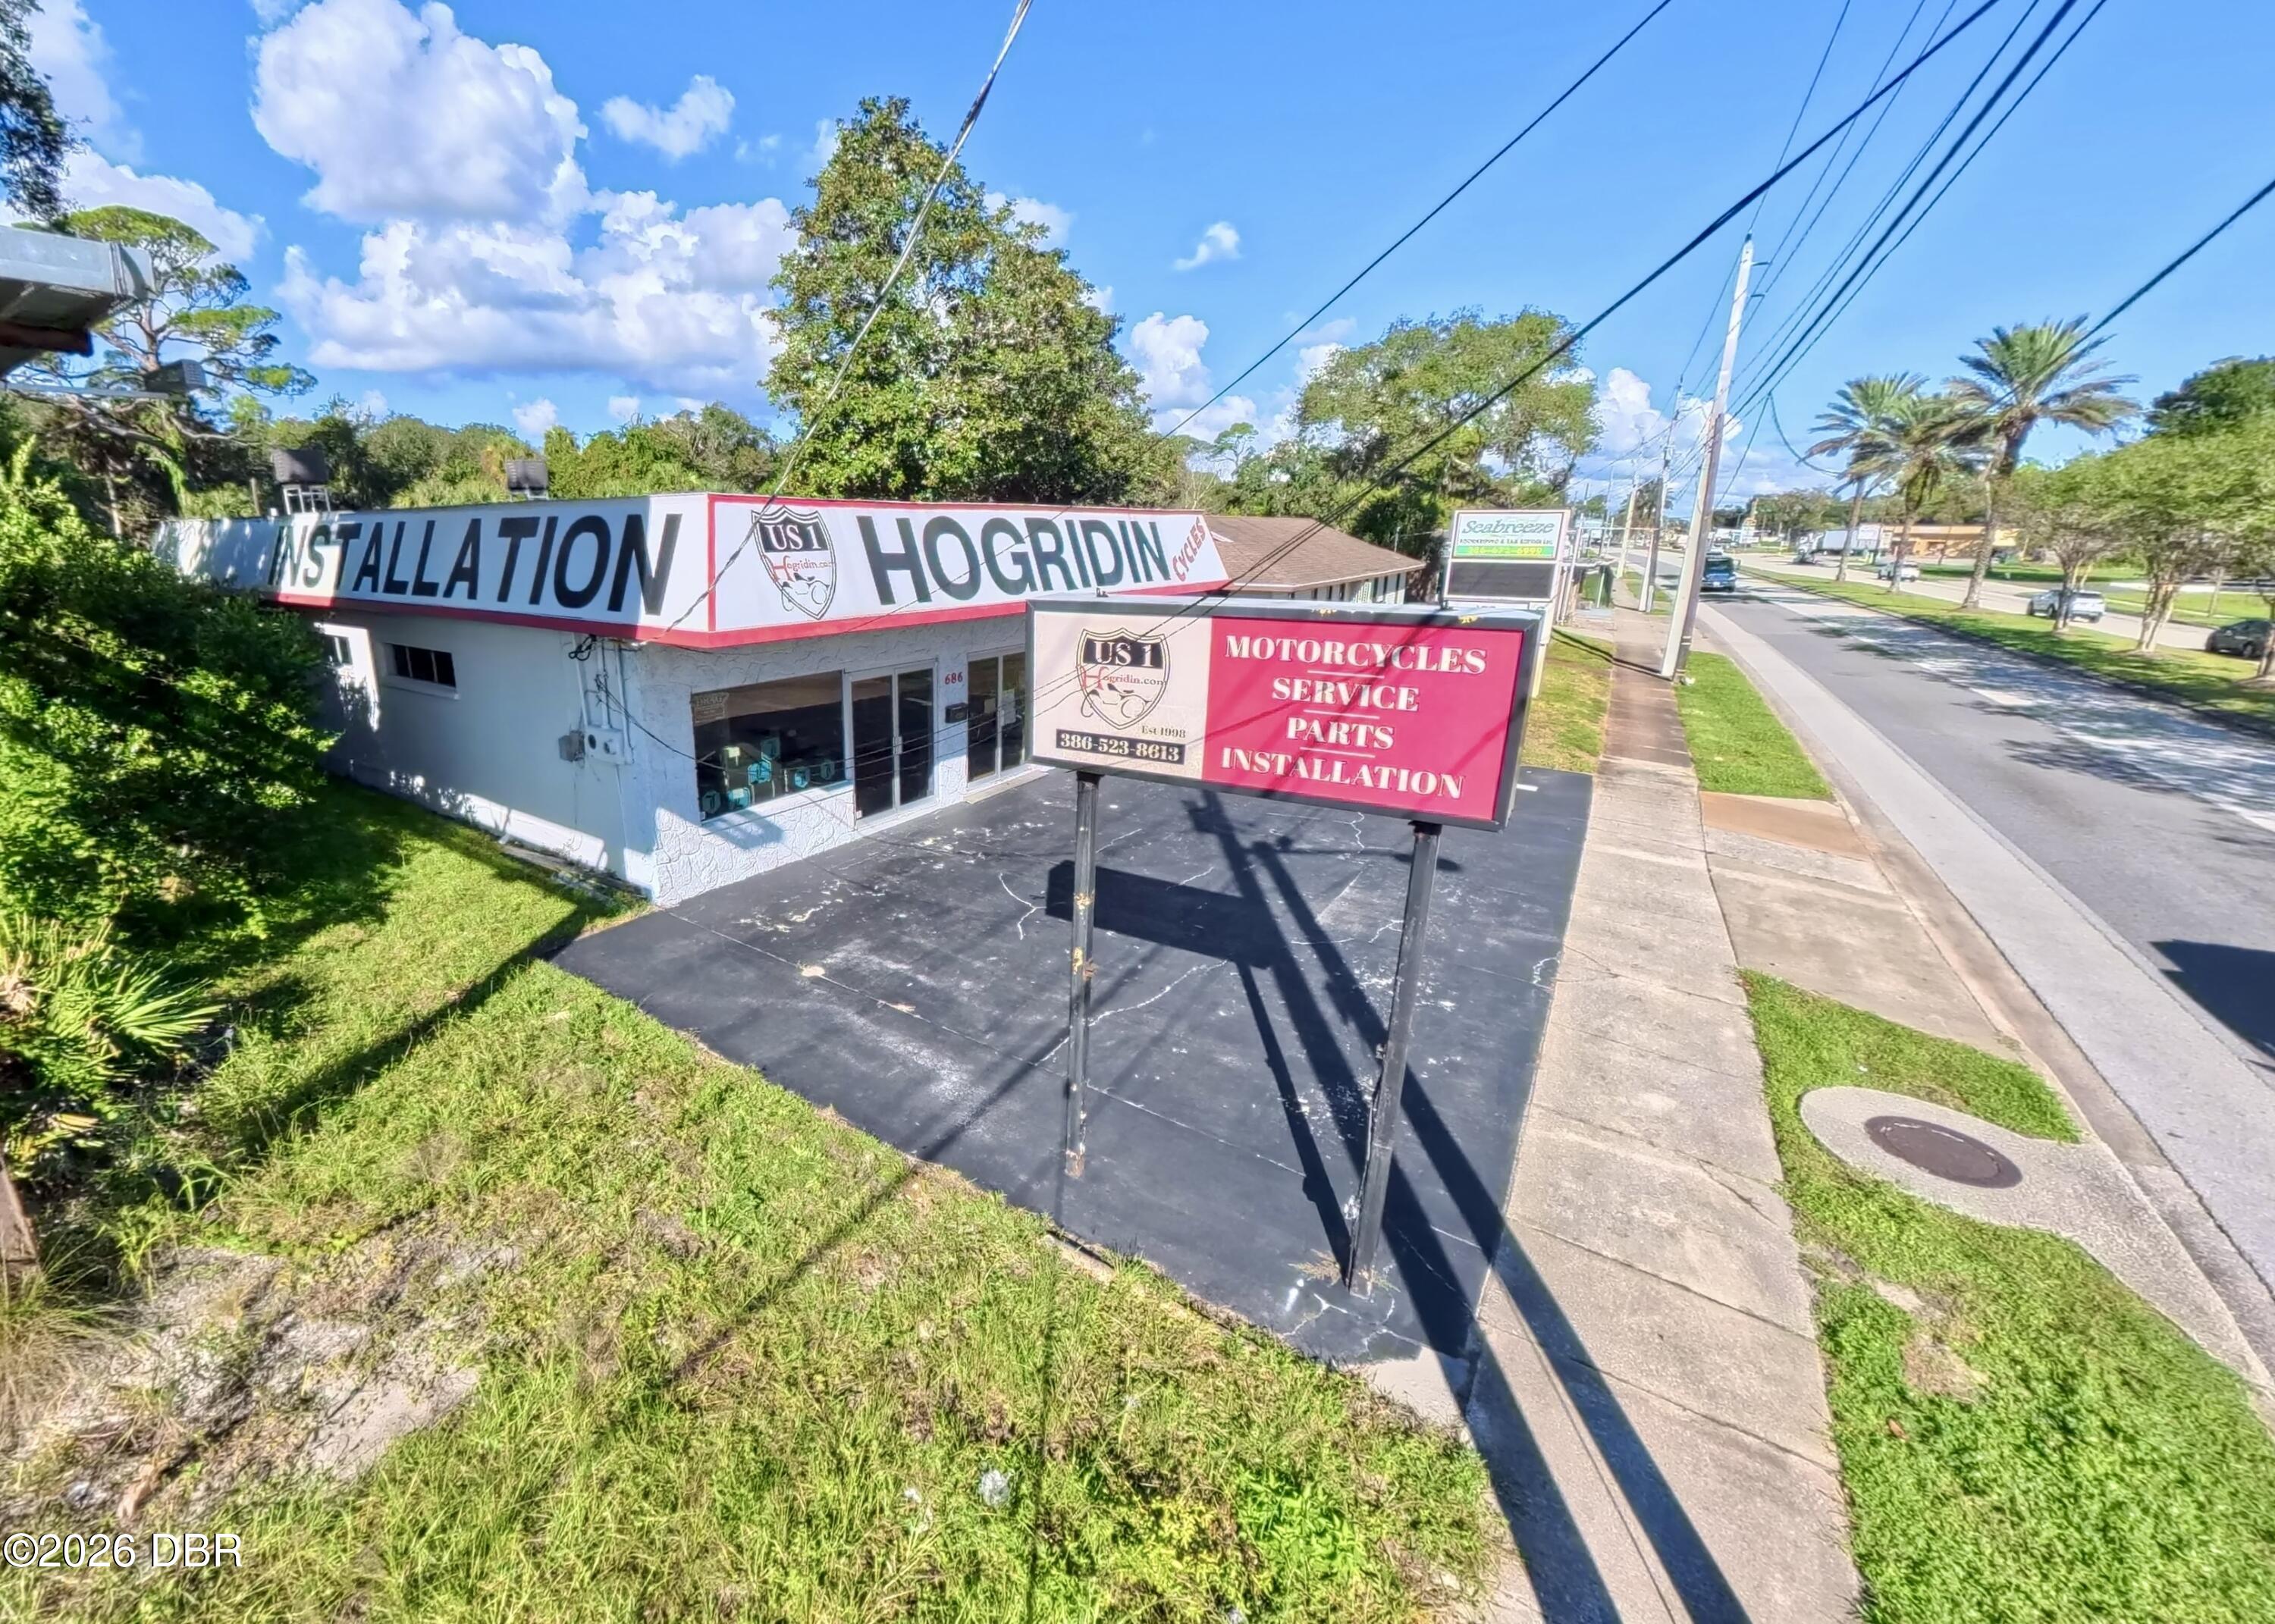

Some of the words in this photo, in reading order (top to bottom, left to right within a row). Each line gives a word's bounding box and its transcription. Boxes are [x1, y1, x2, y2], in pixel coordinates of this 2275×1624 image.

[764, 524, 803, 550] US
[806, 525, 821, 549] 1
[1461, 519, 1555, 534] Seabreeze
[267, 513, 682, 616] INSTALLATION
[856, 515, 1172, 605] HOGRIDIN
[1172, 516, 1206, 582] CYCLES
[1092, 641, 1131, 666] US
[1141, 644, 1153, 667] 1
[1225, 635, 1487, 675] MOTORCYCLES
[945, 672, 963, 685] 686
[1272, 677, 1420, 712] SERVICE
[1060, 732, 1179, 761] 386-523-8613
[1142, 726, 1158, 735] Est
[1160, 728, 1186, 738] 1998
[1286, 716, 1395, 750] PARTS
[1220, 747, 1466, 800] INSTALLATION
